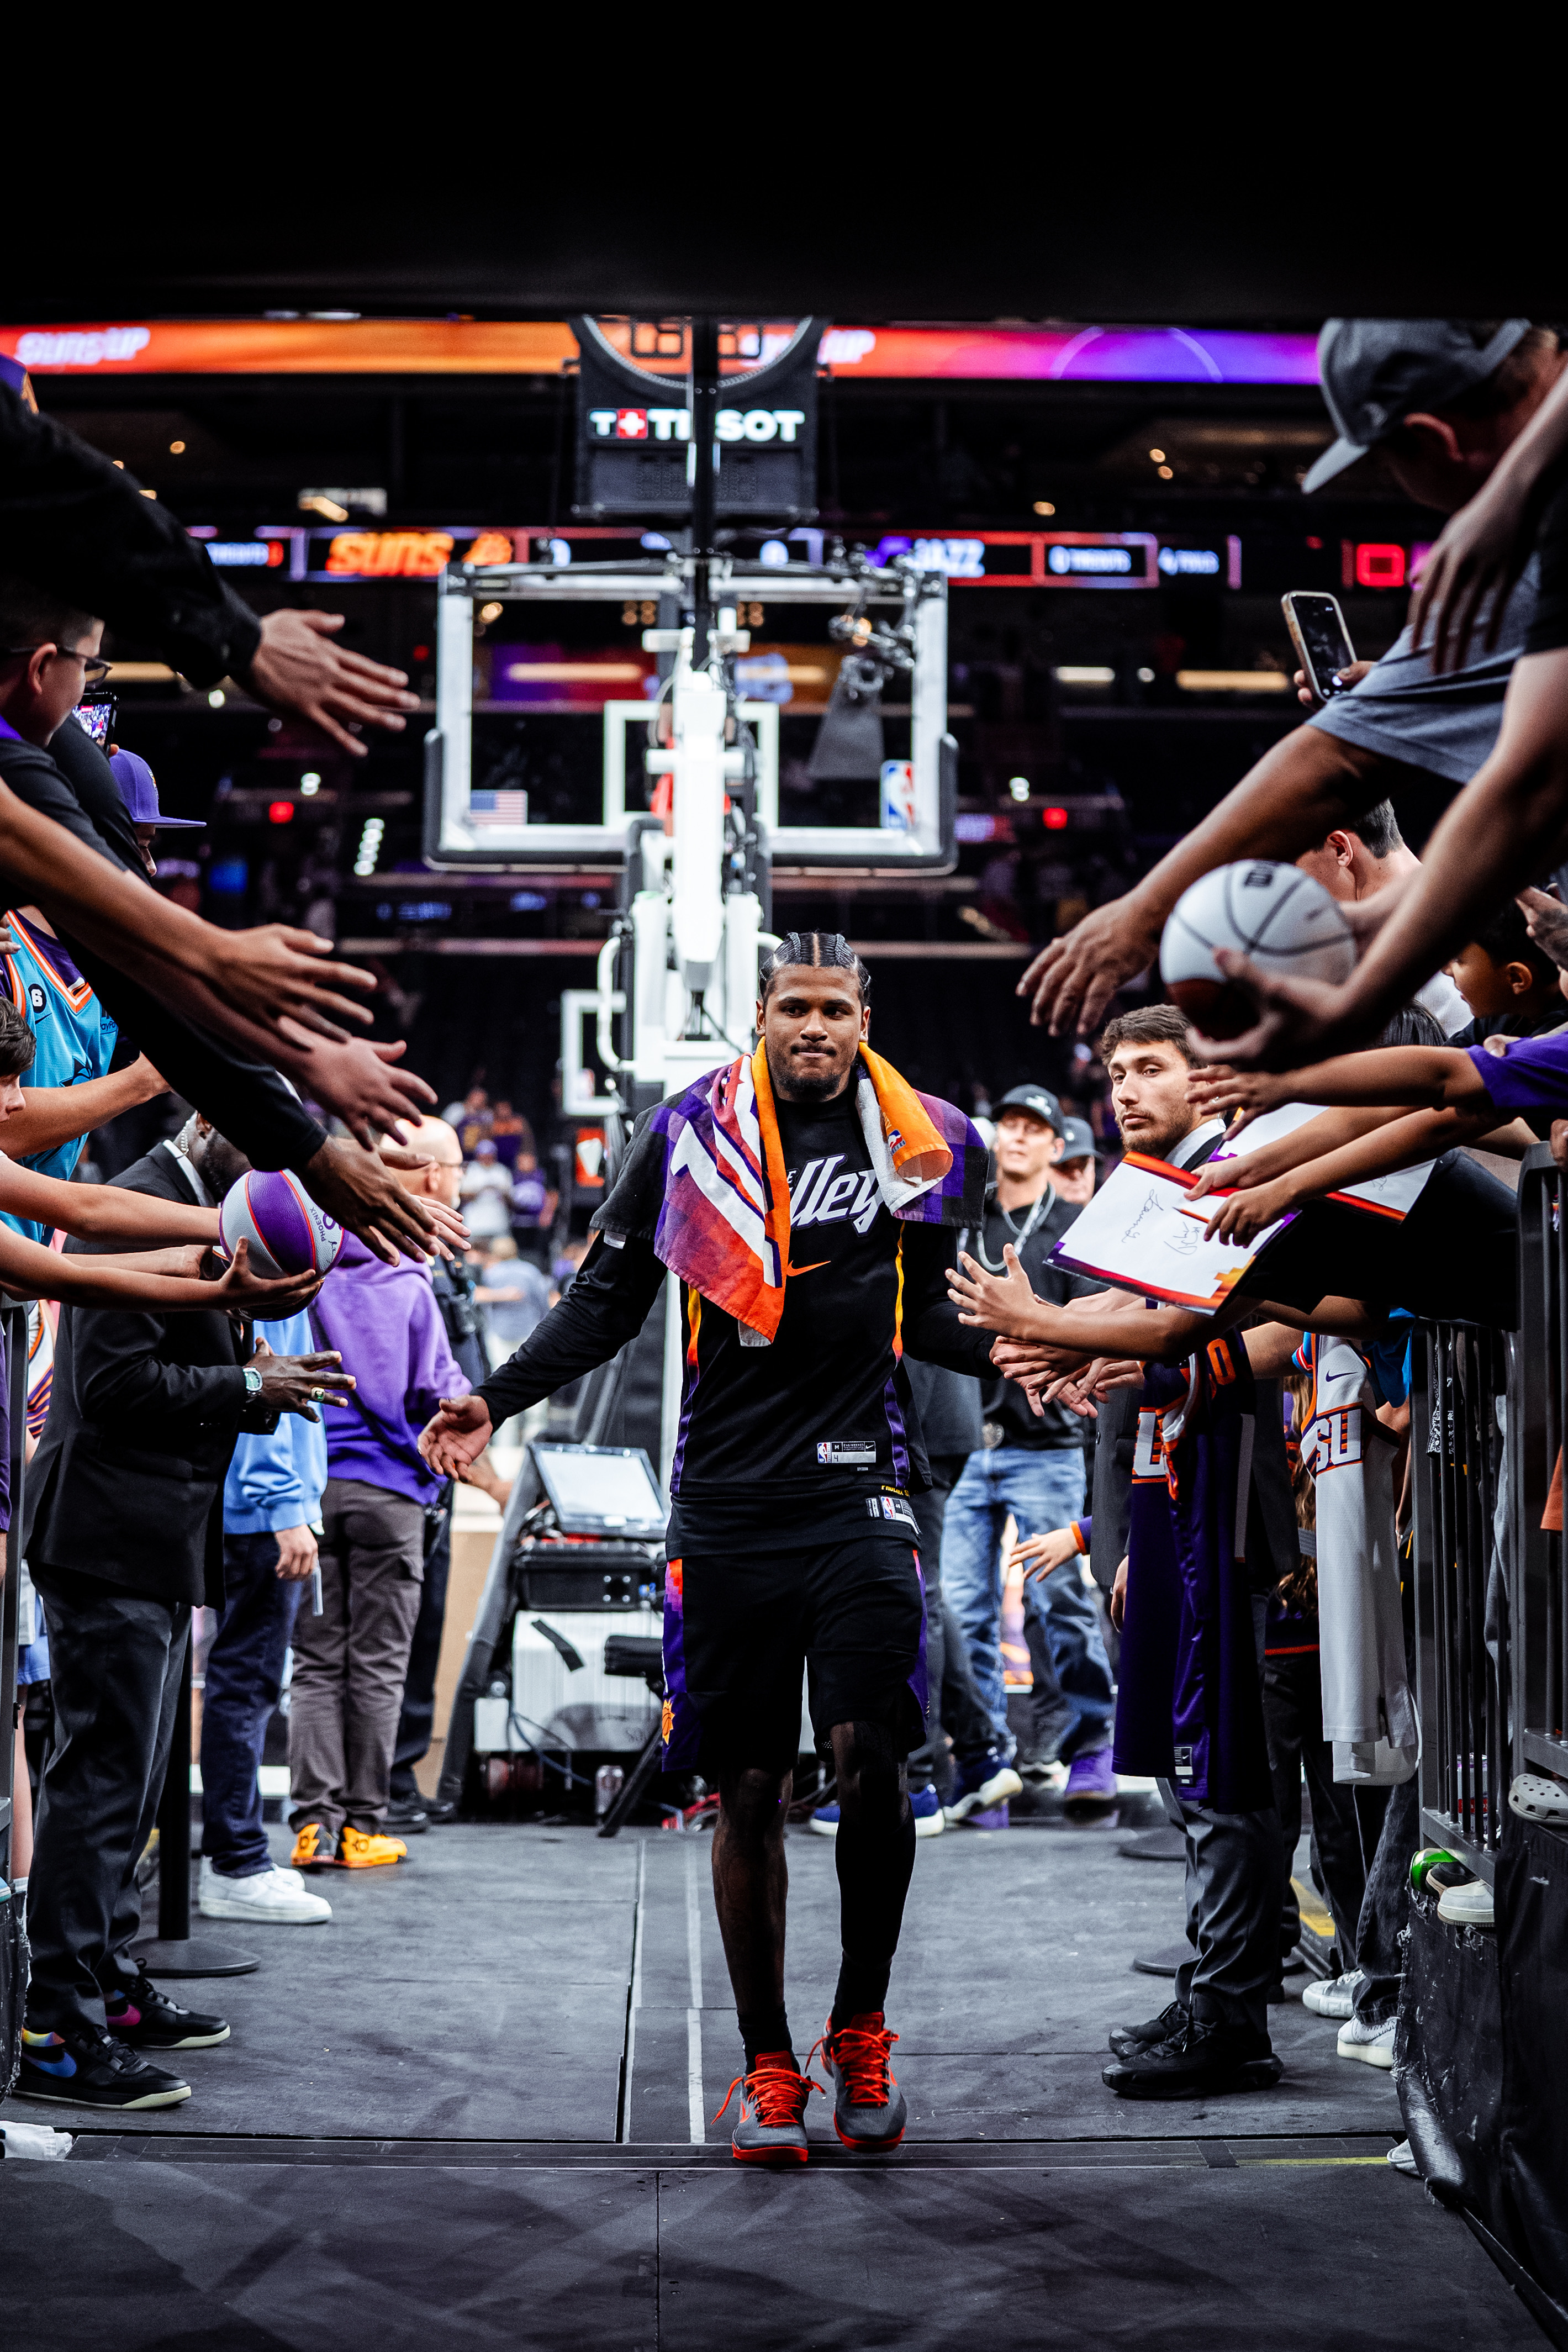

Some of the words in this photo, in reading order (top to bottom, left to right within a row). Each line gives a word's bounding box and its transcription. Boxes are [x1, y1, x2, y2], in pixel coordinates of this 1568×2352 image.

[647, 409, 805, 441] TISOT
[327, 532, 455, 576] SUNS
[30, 988, 43, 1007] 6
[100, 1020, 116, 1032] ayPa
[310, 1207, 326, 1242] PHOENIX
